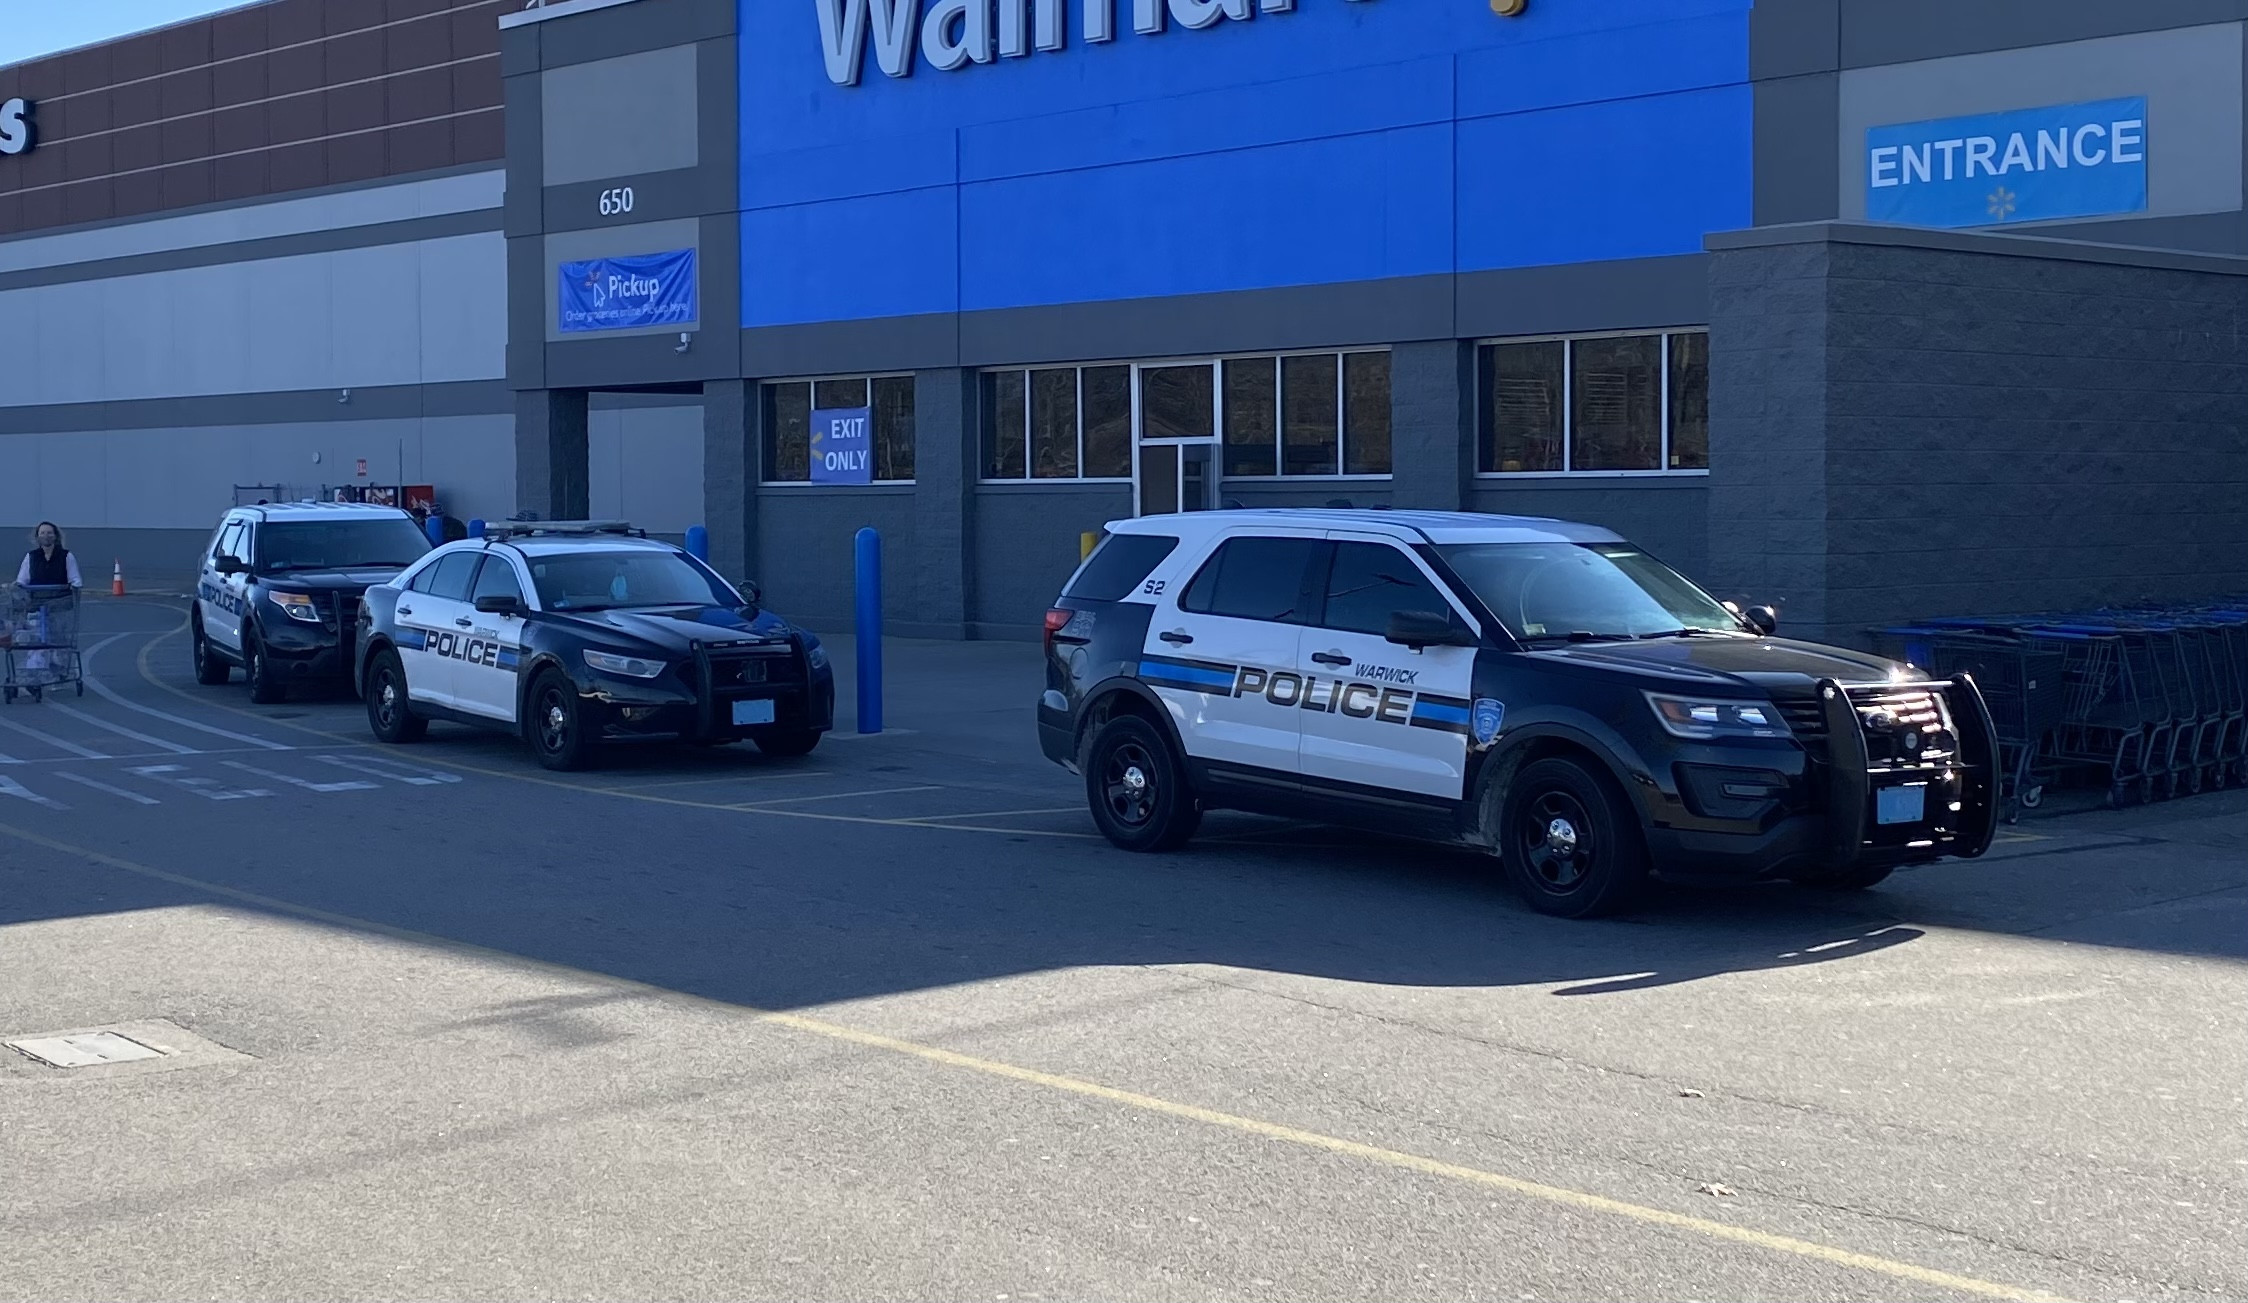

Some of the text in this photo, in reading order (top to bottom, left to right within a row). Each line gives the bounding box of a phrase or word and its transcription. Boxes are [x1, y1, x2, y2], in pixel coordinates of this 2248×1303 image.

[814, 0, 1300, 86] Walm
[1870, 119, 2144, 188] ENTRANCE
[599, 187, 634, 216] 650
[608, 273, 660, 302] Pickup
[566, 310, 587, 321] Order
[831, 417, 865, 439] EXIT
[825, 449, 868, 471] ONLY
[1143, 579, 1166, 596] S2
[424, 629, 499, 667] POLICE
[1354, 662, 1420, 685] WARWICK
[1233, 665, 1414, 725] POLICE
